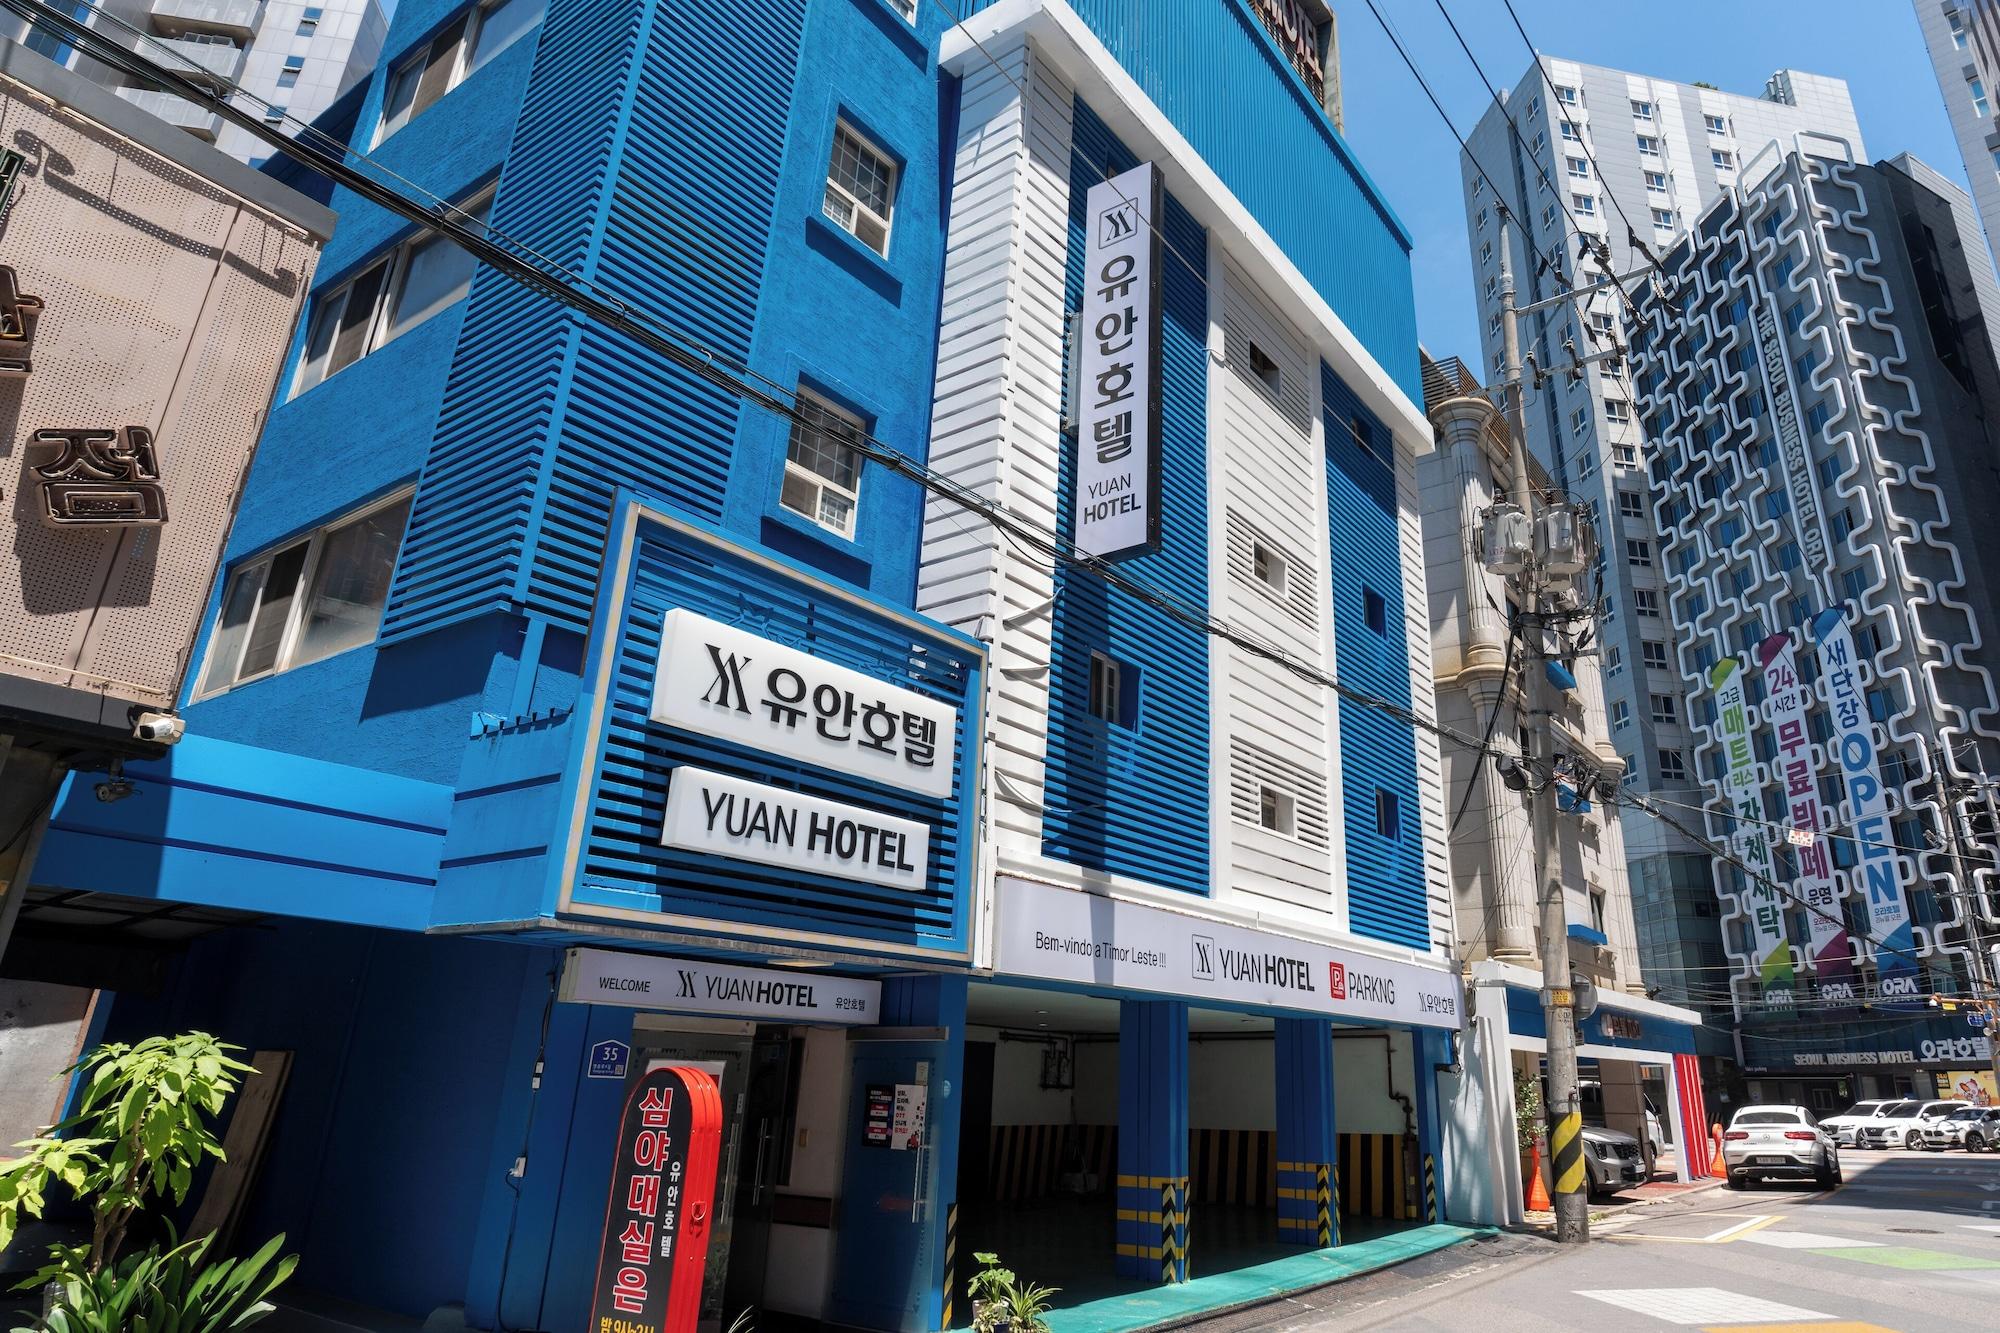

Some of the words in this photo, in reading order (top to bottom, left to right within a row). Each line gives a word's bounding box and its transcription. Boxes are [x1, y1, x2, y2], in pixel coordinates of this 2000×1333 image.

[1756, 307, 1775, 339] THE
[1093, 254, 1138, 464] 유안호텔
[1763, 338, 1786, 393] SEOUL
[1773, 392, 1804, 471] BUSINESS
[1088, 473, 1131, 499] YUAN
[1791, 470, 1817, 528] HOTEL
[1084, 492, 1142, 525] HOTEL
[1803, 526, 1825, 569] ORA
[1720, 686, 1741, 706] 고급
[1768, 664, 1795, 696] 24
[1827, 638, 1859, 729] 새단장
[761, 668, 937, 767] 유안호텔
[702, 788, 798, 847] YUAN
[807, 811, 914, 872] HOTEL
[1841, 732, 1898, 904] OPEN
[1808, 886, 1833, 906] 운영
[1035, 931, 1092, 956] Bem-vindo
[1103, 942, 1130, 960] Timor
[1219, 948, 1262, 983] YUAN
[1264, 953, 1315, 992] HOTEL
[1882, 978, 1918, 995] ORA
[599, 977, 651, 993] WELCOME
[705, 975, 755, 1001] YUAN
[756, 980, 818, 1008] HOTEL
[834, 996, 866, 1012] 유안호텔
[1348, 971, 1395, 1005] PARKNG
[1426, 993, 1455, 1016] 유안호텔
[1765, 989, 1793, 1004] ORA
[1821, 983, 1854, 999] ORA
[603, 1047, 618, 1061] 35
[1793, 1054, 1827, 1066] SEOUL
[1827, 1052, 1878, 1065] BUSINESS
[1878, 1050, 1918, 1064] HOTEL
[1920, 1037, 1992, 1063] 오라호텔
[661, 1161, 681, 1257] 유안호텔
